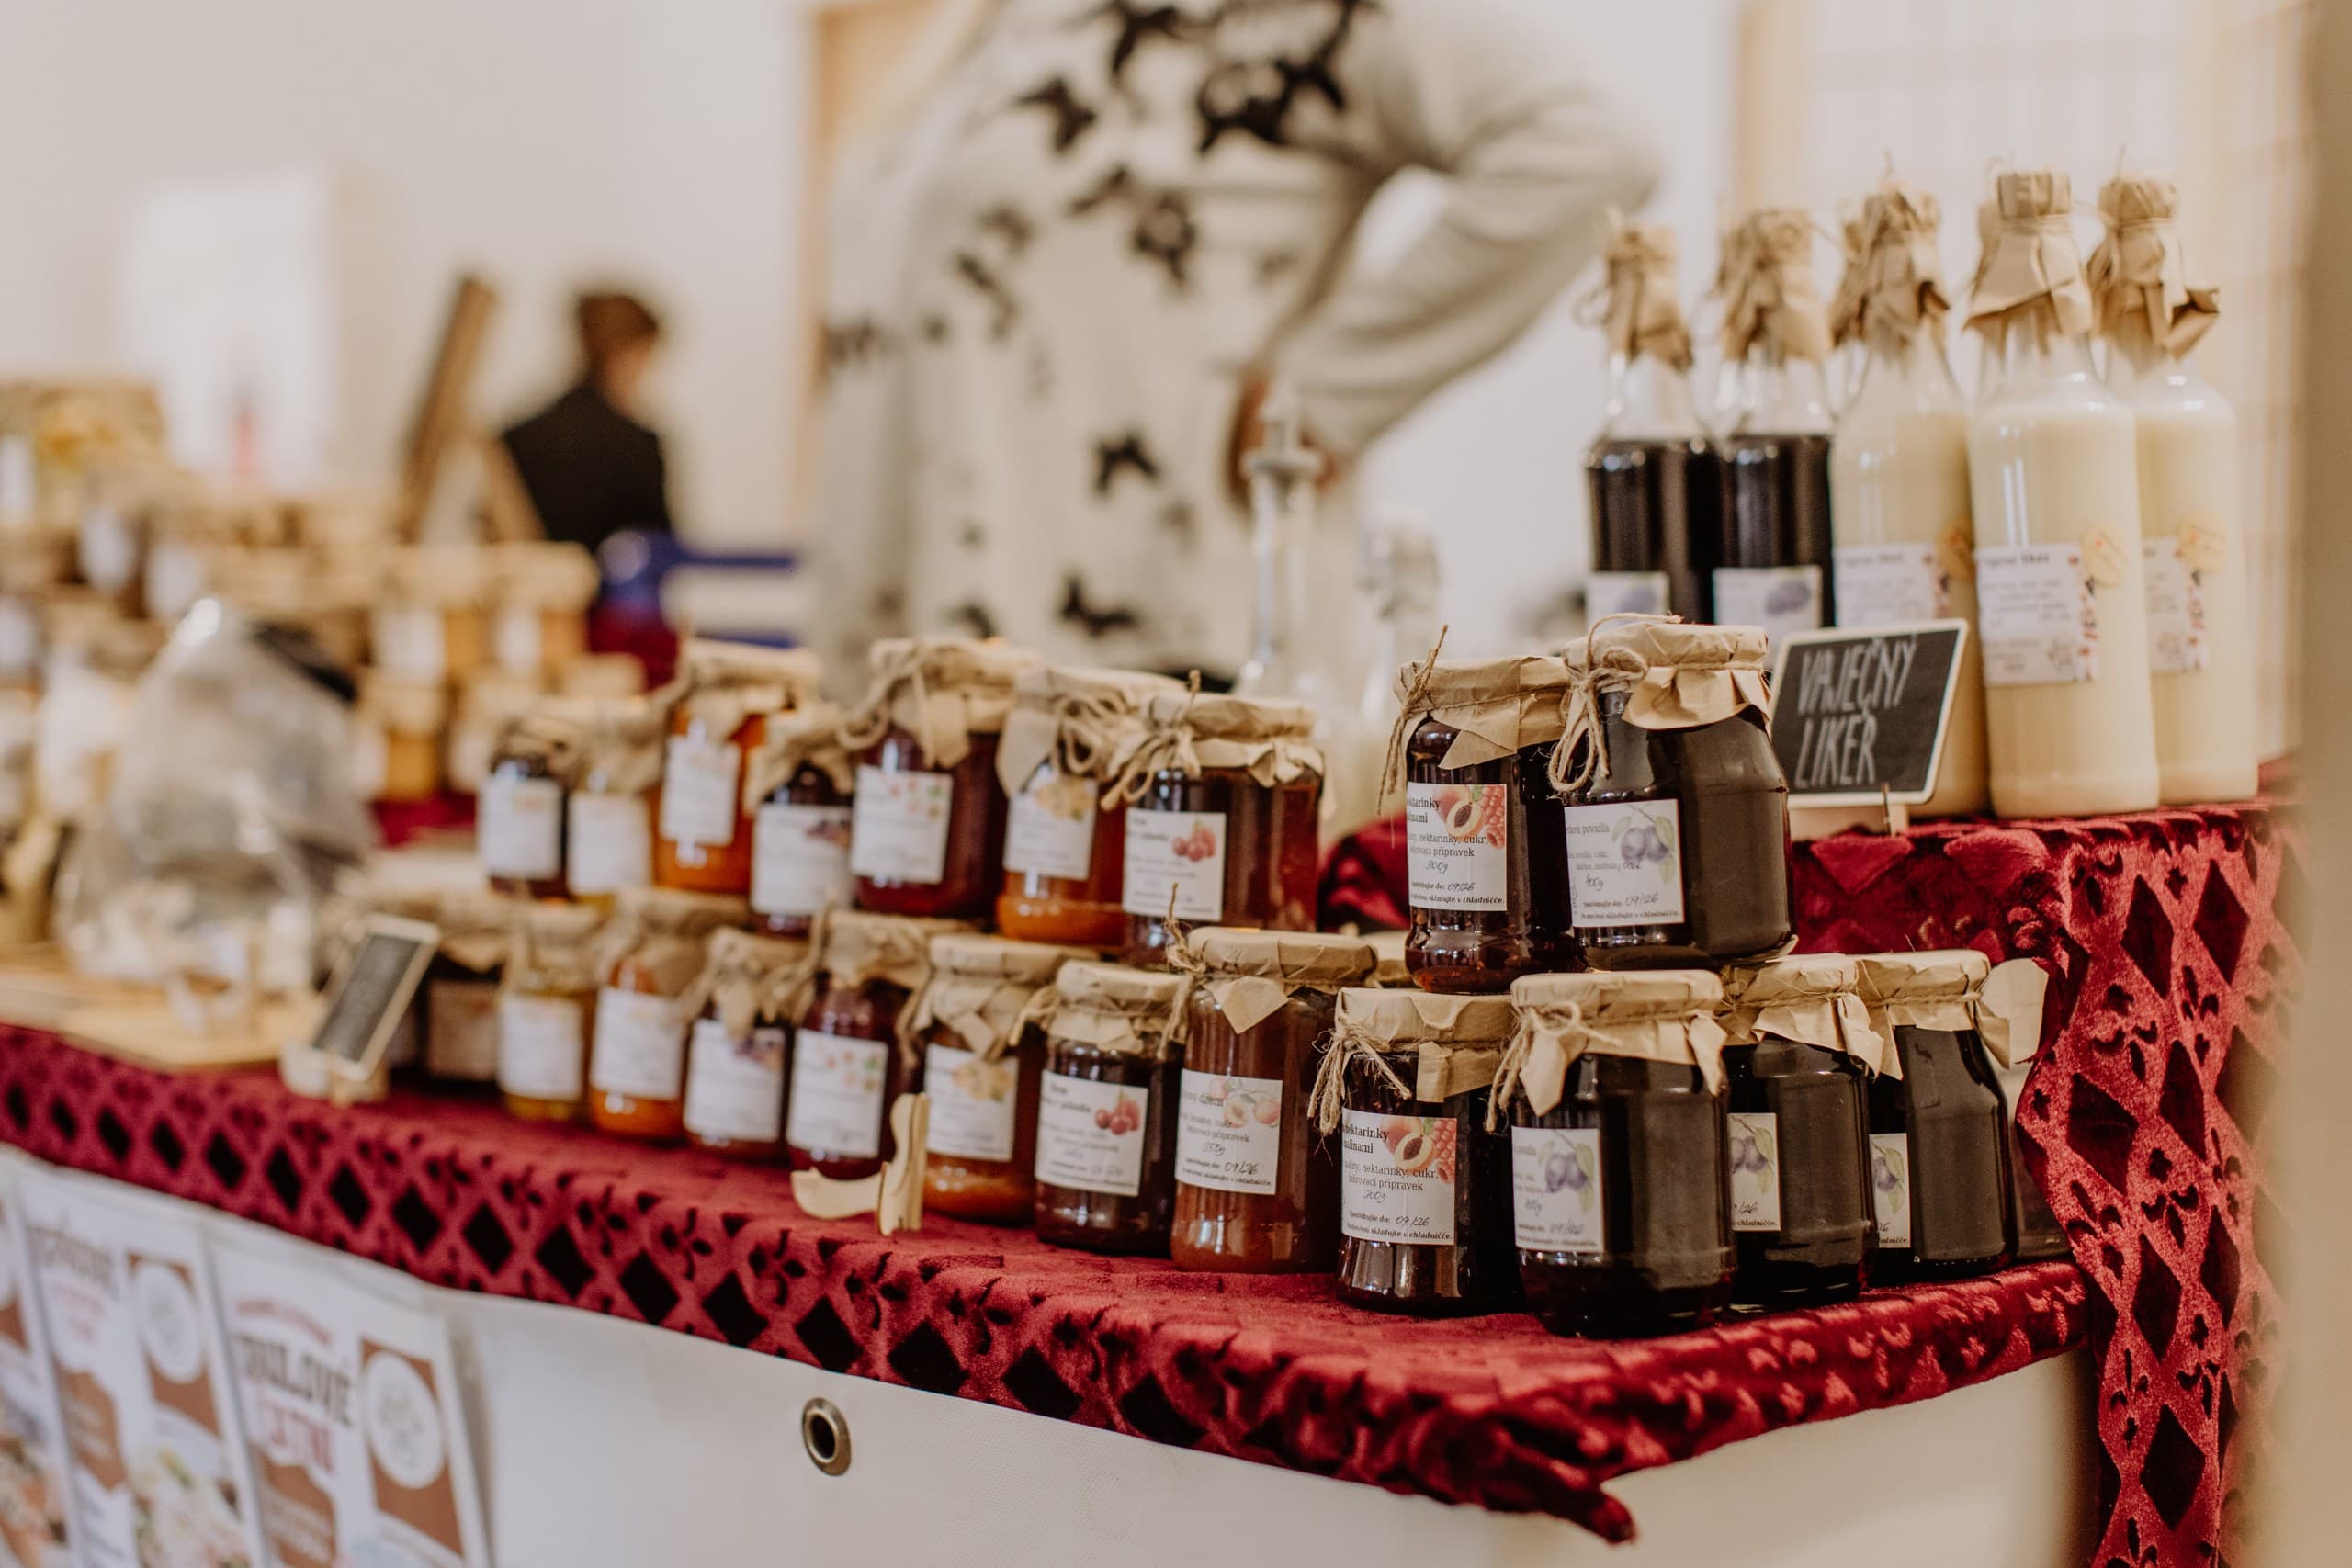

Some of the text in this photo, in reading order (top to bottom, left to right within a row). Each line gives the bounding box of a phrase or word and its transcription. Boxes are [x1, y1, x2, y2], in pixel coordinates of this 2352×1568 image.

[1794, 707, 1878, 788] LIKÉR
[1412, 1168, 1439, 1179] cukr,
[1378, 1179, 1425, 1191] přípravek
